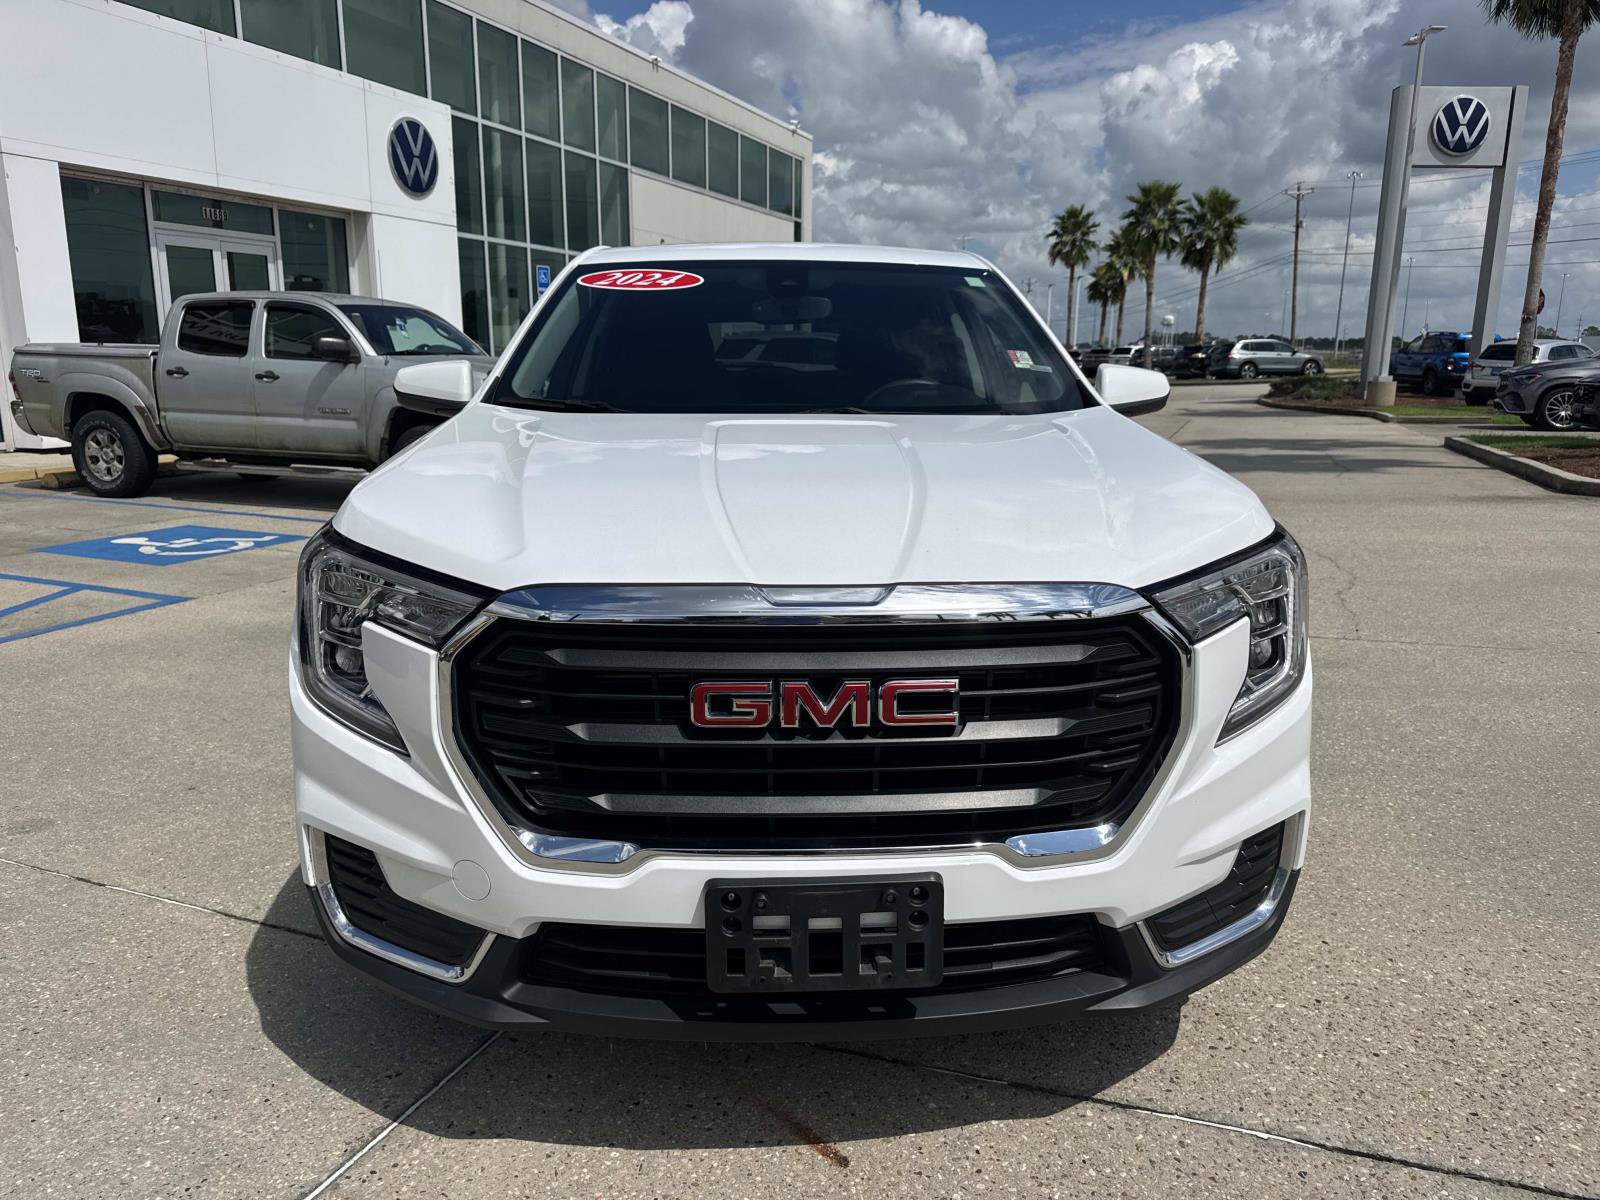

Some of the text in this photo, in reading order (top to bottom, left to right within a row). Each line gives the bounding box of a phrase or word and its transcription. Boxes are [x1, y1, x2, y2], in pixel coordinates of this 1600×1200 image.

[1437, 97, 1490, 151] VW
[389, 118, 437, 191] VW
[593, 272, 687, 287] 2024
[690, 679, 960, 729] GMC
